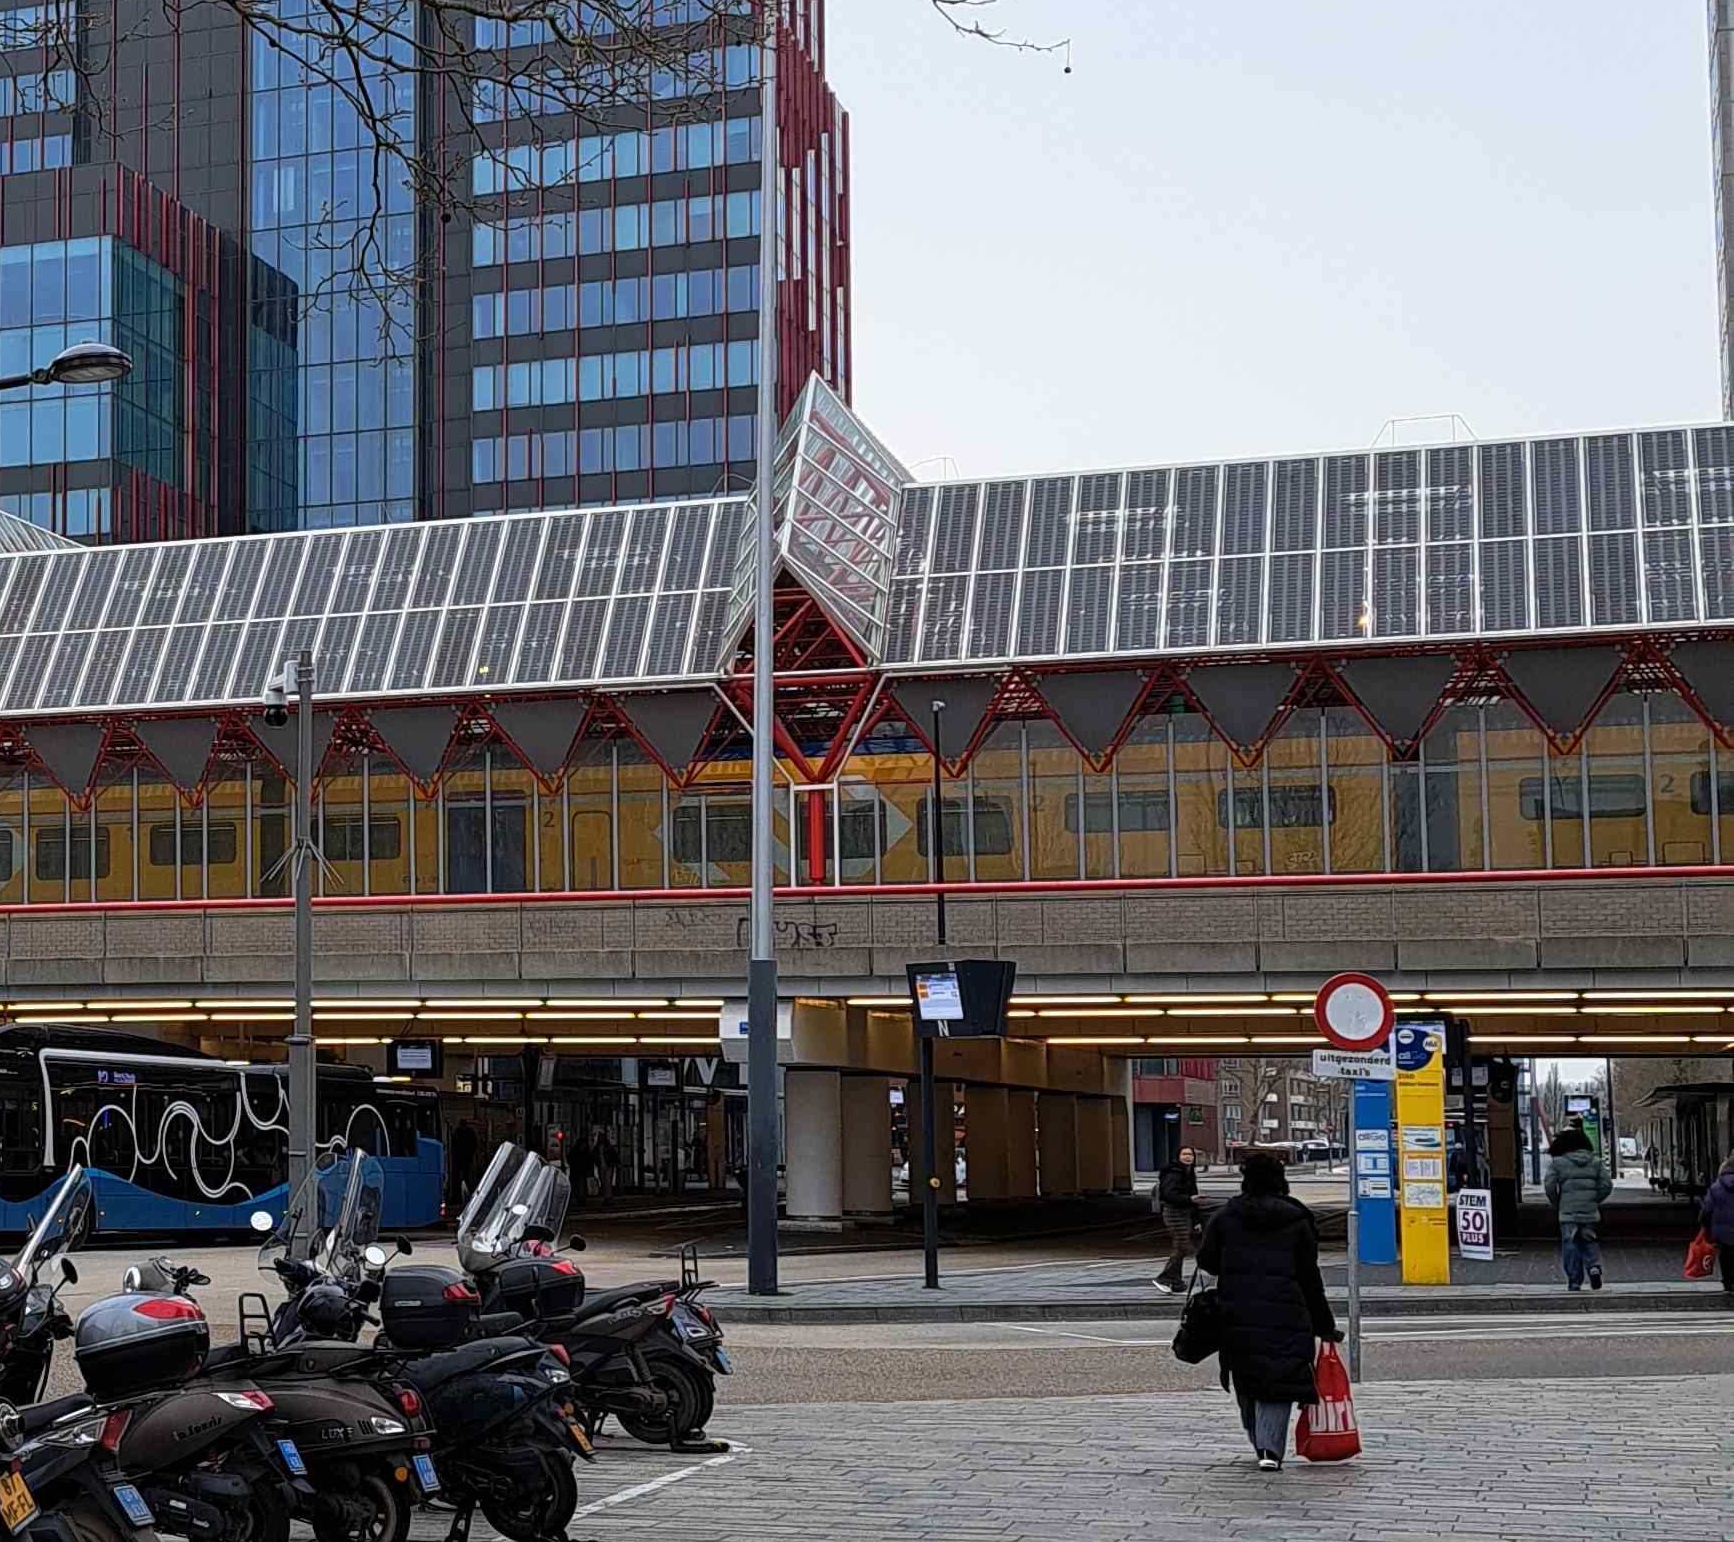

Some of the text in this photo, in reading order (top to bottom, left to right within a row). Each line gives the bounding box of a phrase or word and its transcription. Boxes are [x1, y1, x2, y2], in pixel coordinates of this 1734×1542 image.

[543, 812, 555, 828] 2
[937, 1019, 949, 1036] N
[1320, 1053, 1391, 1065] uitgezonderd
[1458, 1195, 1486, 1207] STEM
[1461, 1211, 1484, 1231] 50
[1460, 1232, 1484, 1244] PLUS
[1, 1492, 34, 1526] MF-FL
